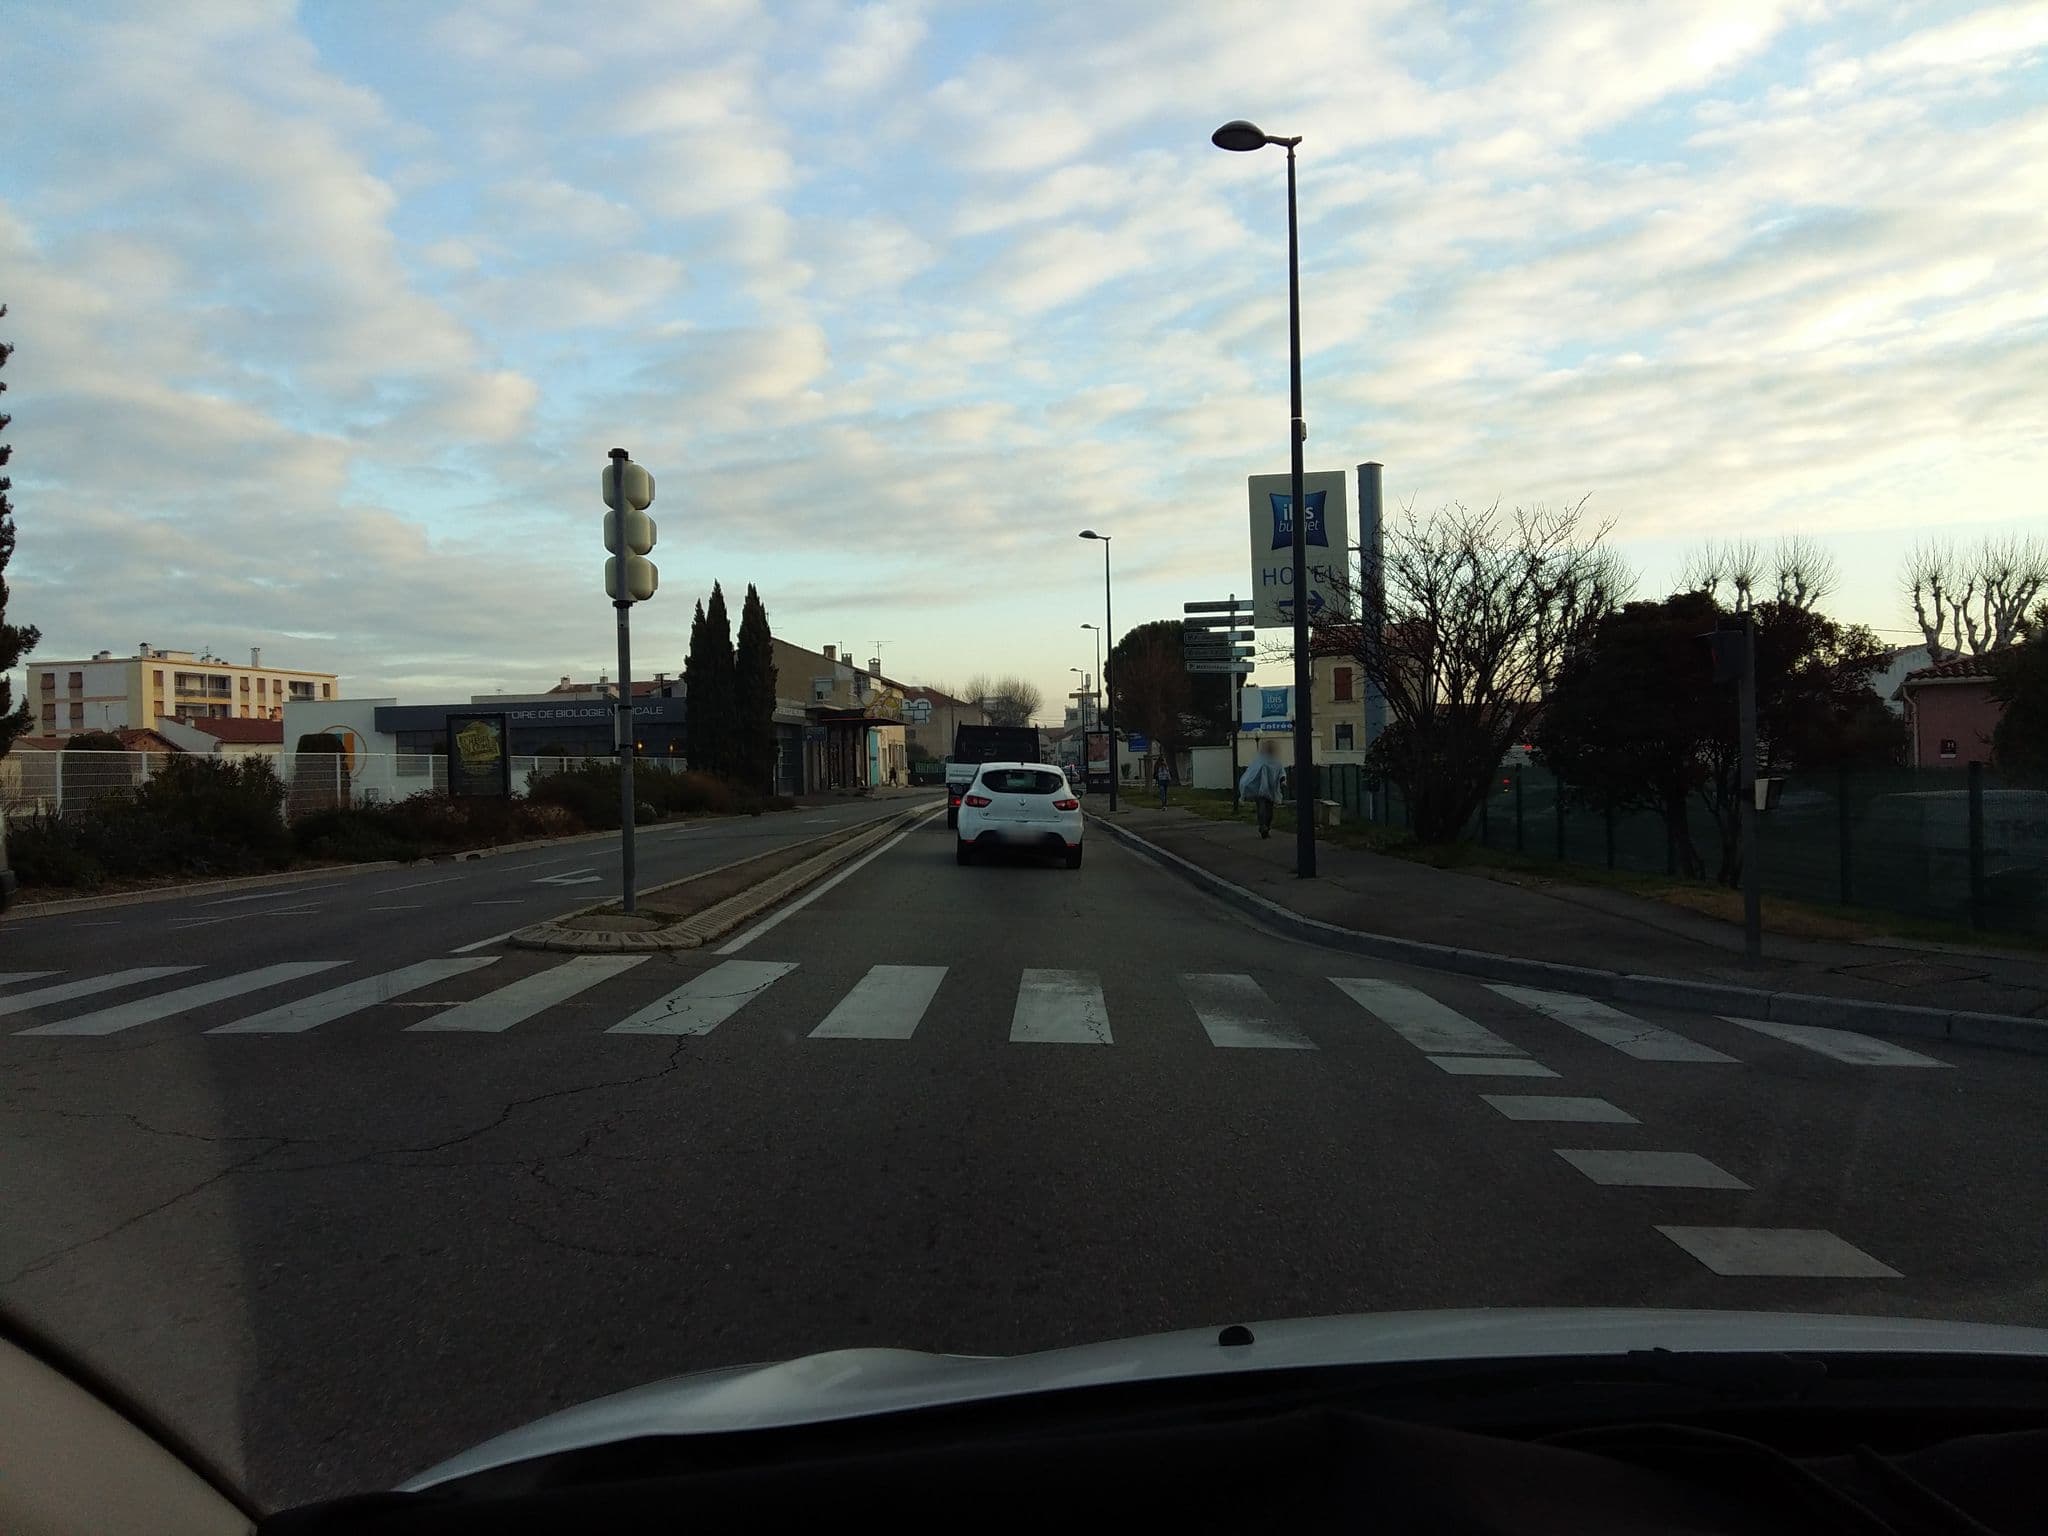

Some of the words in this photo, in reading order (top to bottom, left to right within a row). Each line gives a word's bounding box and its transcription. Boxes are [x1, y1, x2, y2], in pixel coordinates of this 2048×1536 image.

[1283, 503, 1314, 520] is
[1278, 520, 1320, 533] buet
[1262, 564, 1337, 586] HOEL
[538, 710, 554, 719] DE
[555, 708, 605, 718] BIOLOGIE
